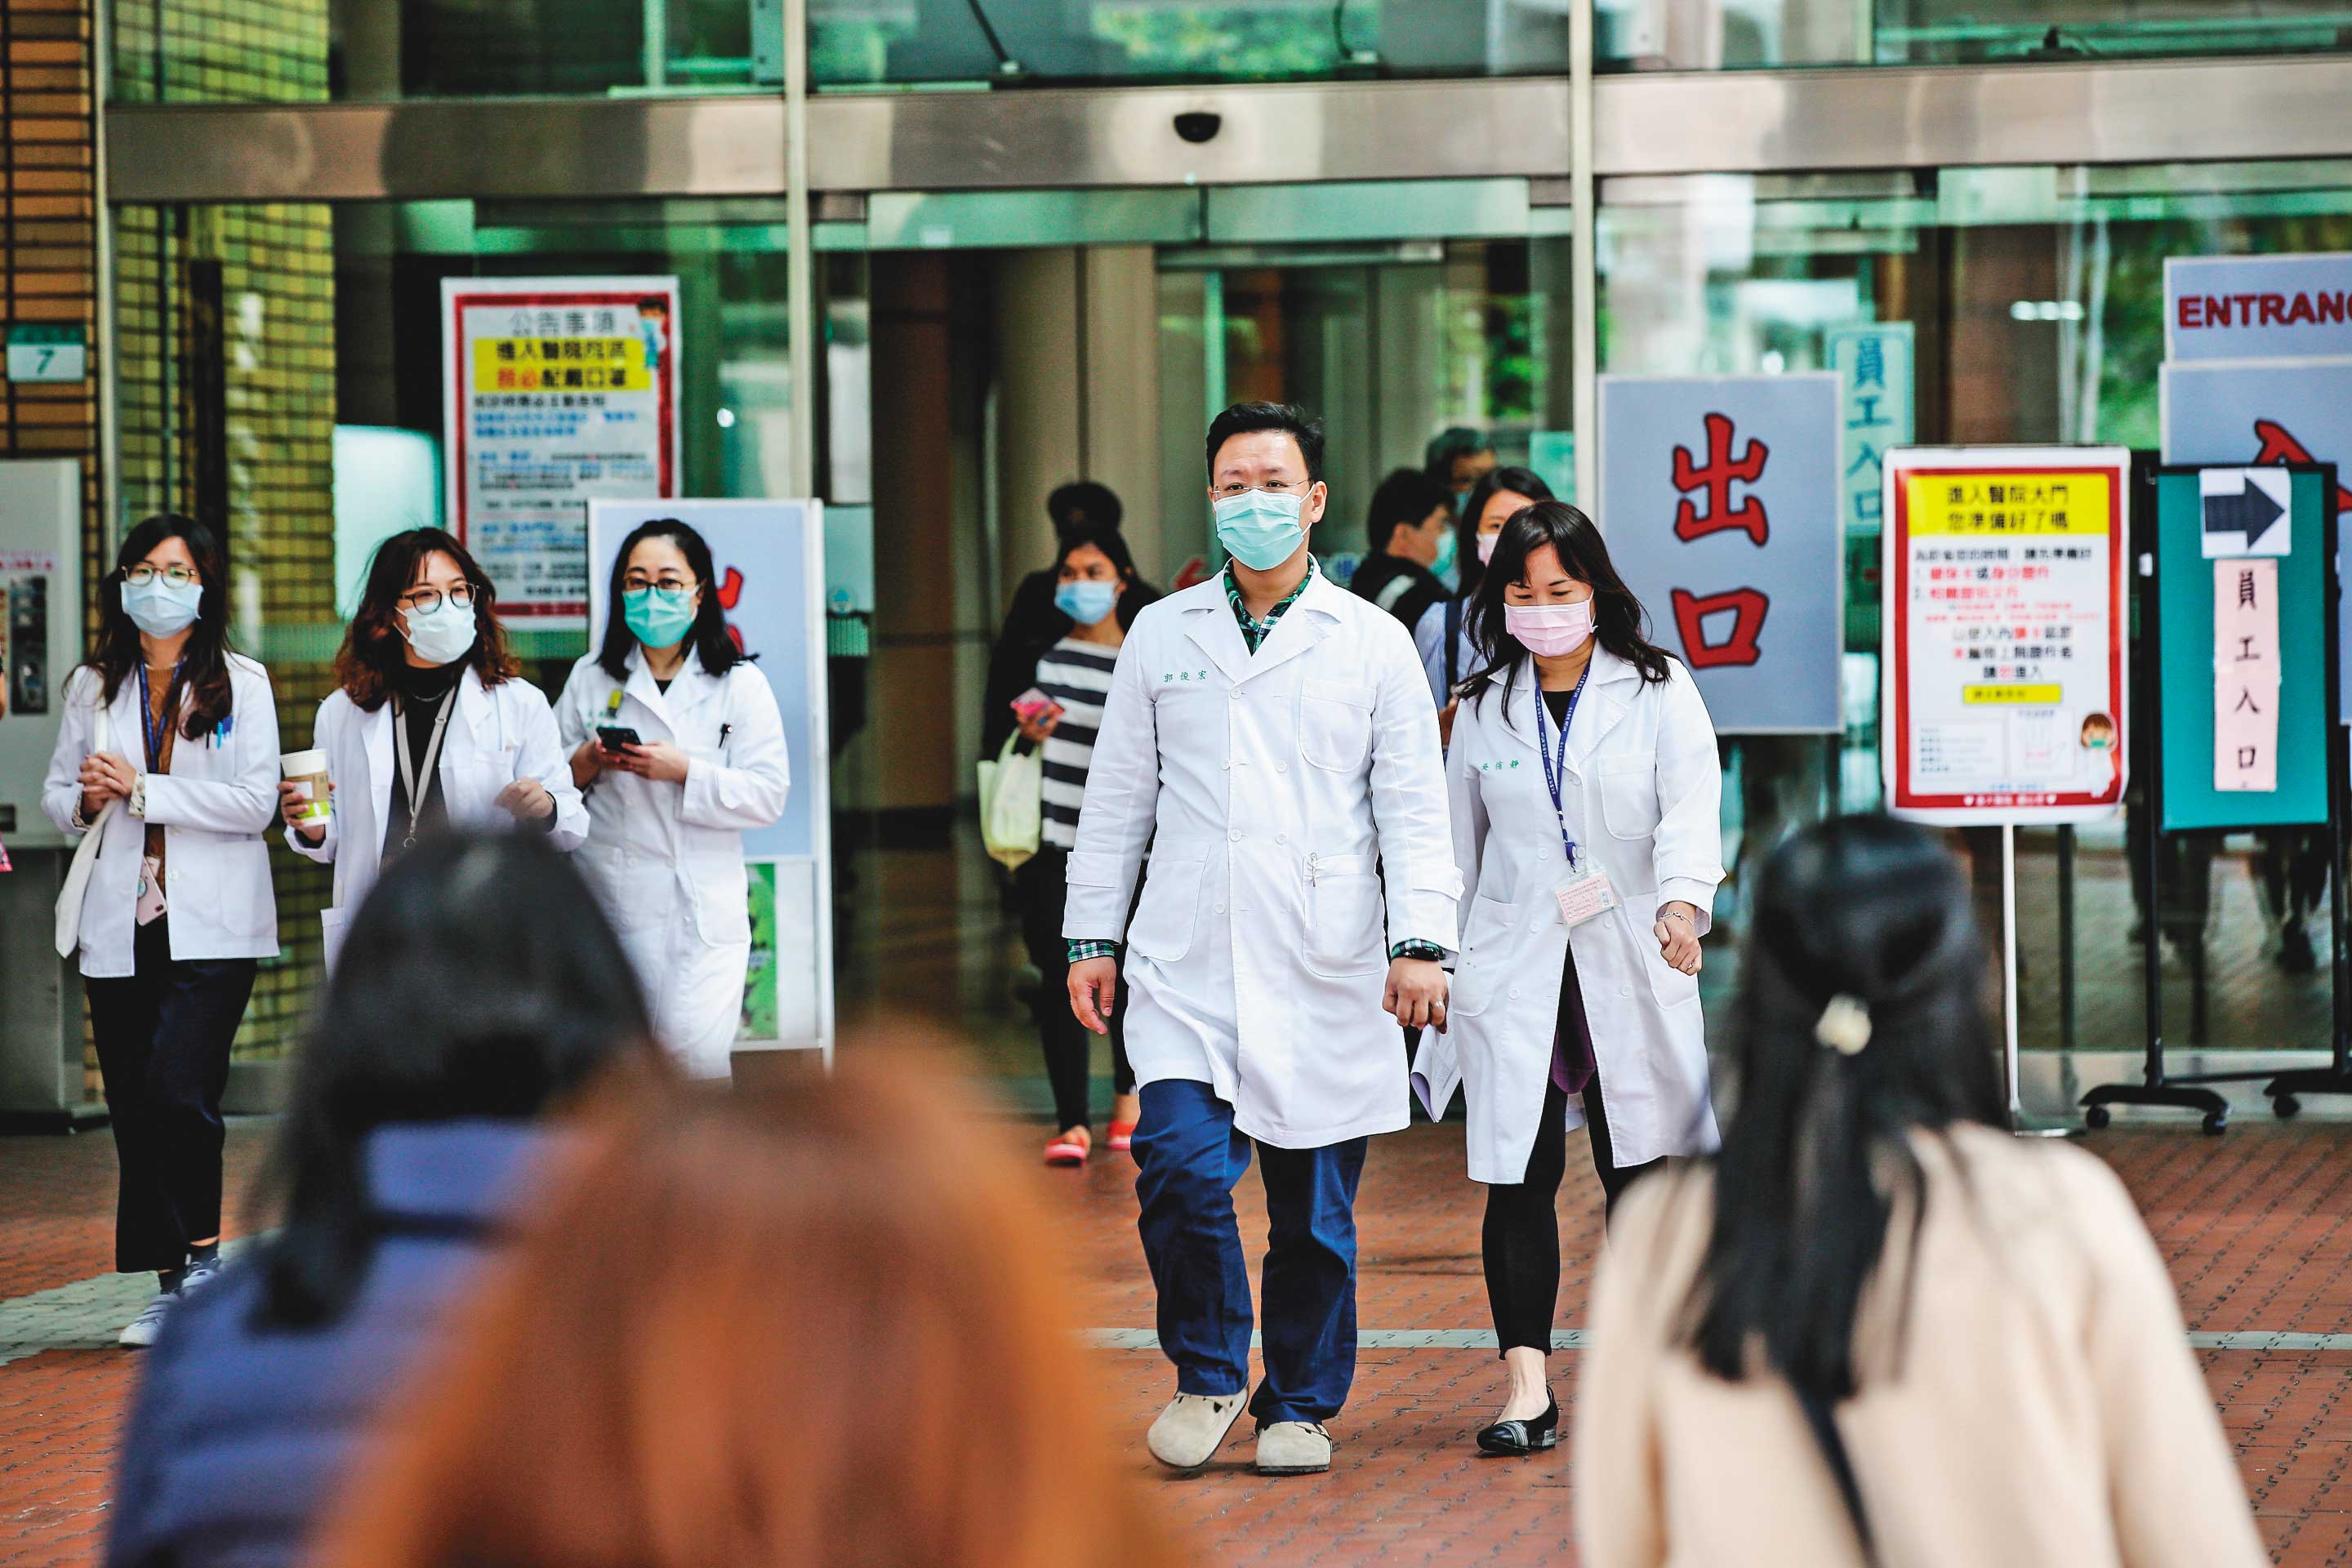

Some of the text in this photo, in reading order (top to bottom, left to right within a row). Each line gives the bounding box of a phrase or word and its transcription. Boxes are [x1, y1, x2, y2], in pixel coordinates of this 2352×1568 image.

[510, 310, 615, 336] 公告事項
[2178, 292, 2352, 329] ENTRAN
[37, 349, 55, 376] 7
[1846, 337, 1891, 521] 員工入口
[1947, 485, 2069, 506] 進入醫院大門
[1948, 511, 2069, 531] 您準備好了嗎
[1670, 412, 1770, 670] 出口
[2234, 568, 2261, 768] 員工入口
